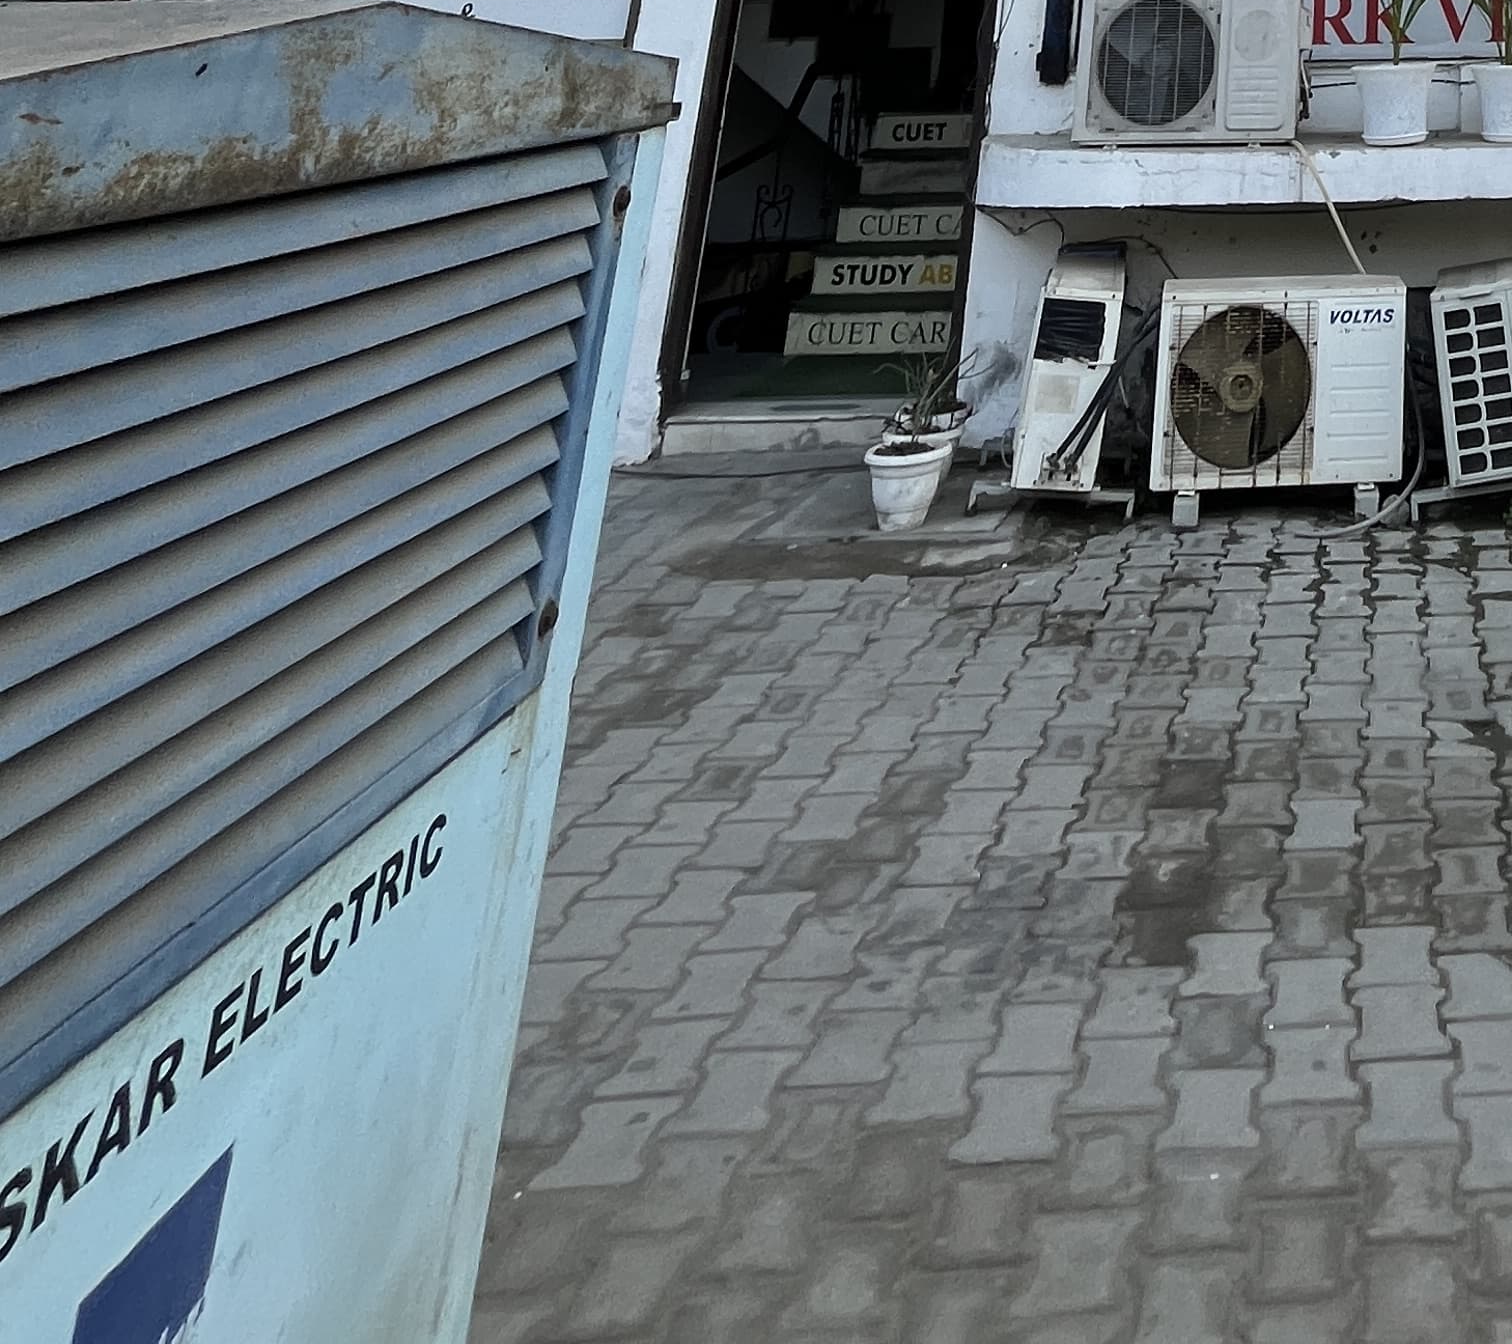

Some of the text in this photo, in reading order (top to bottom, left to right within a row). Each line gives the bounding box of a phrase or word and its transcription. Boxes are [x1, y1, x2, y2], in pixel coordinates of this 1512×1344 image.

[892, 122, 948, 142] CUET
[830, 263, 915, 287] STUDY
[1329, 307, 1395, 326] VOLTAS
[808, 321, 883, 346] CUET
[201, 813, 448, 1080] ELECTRIC
